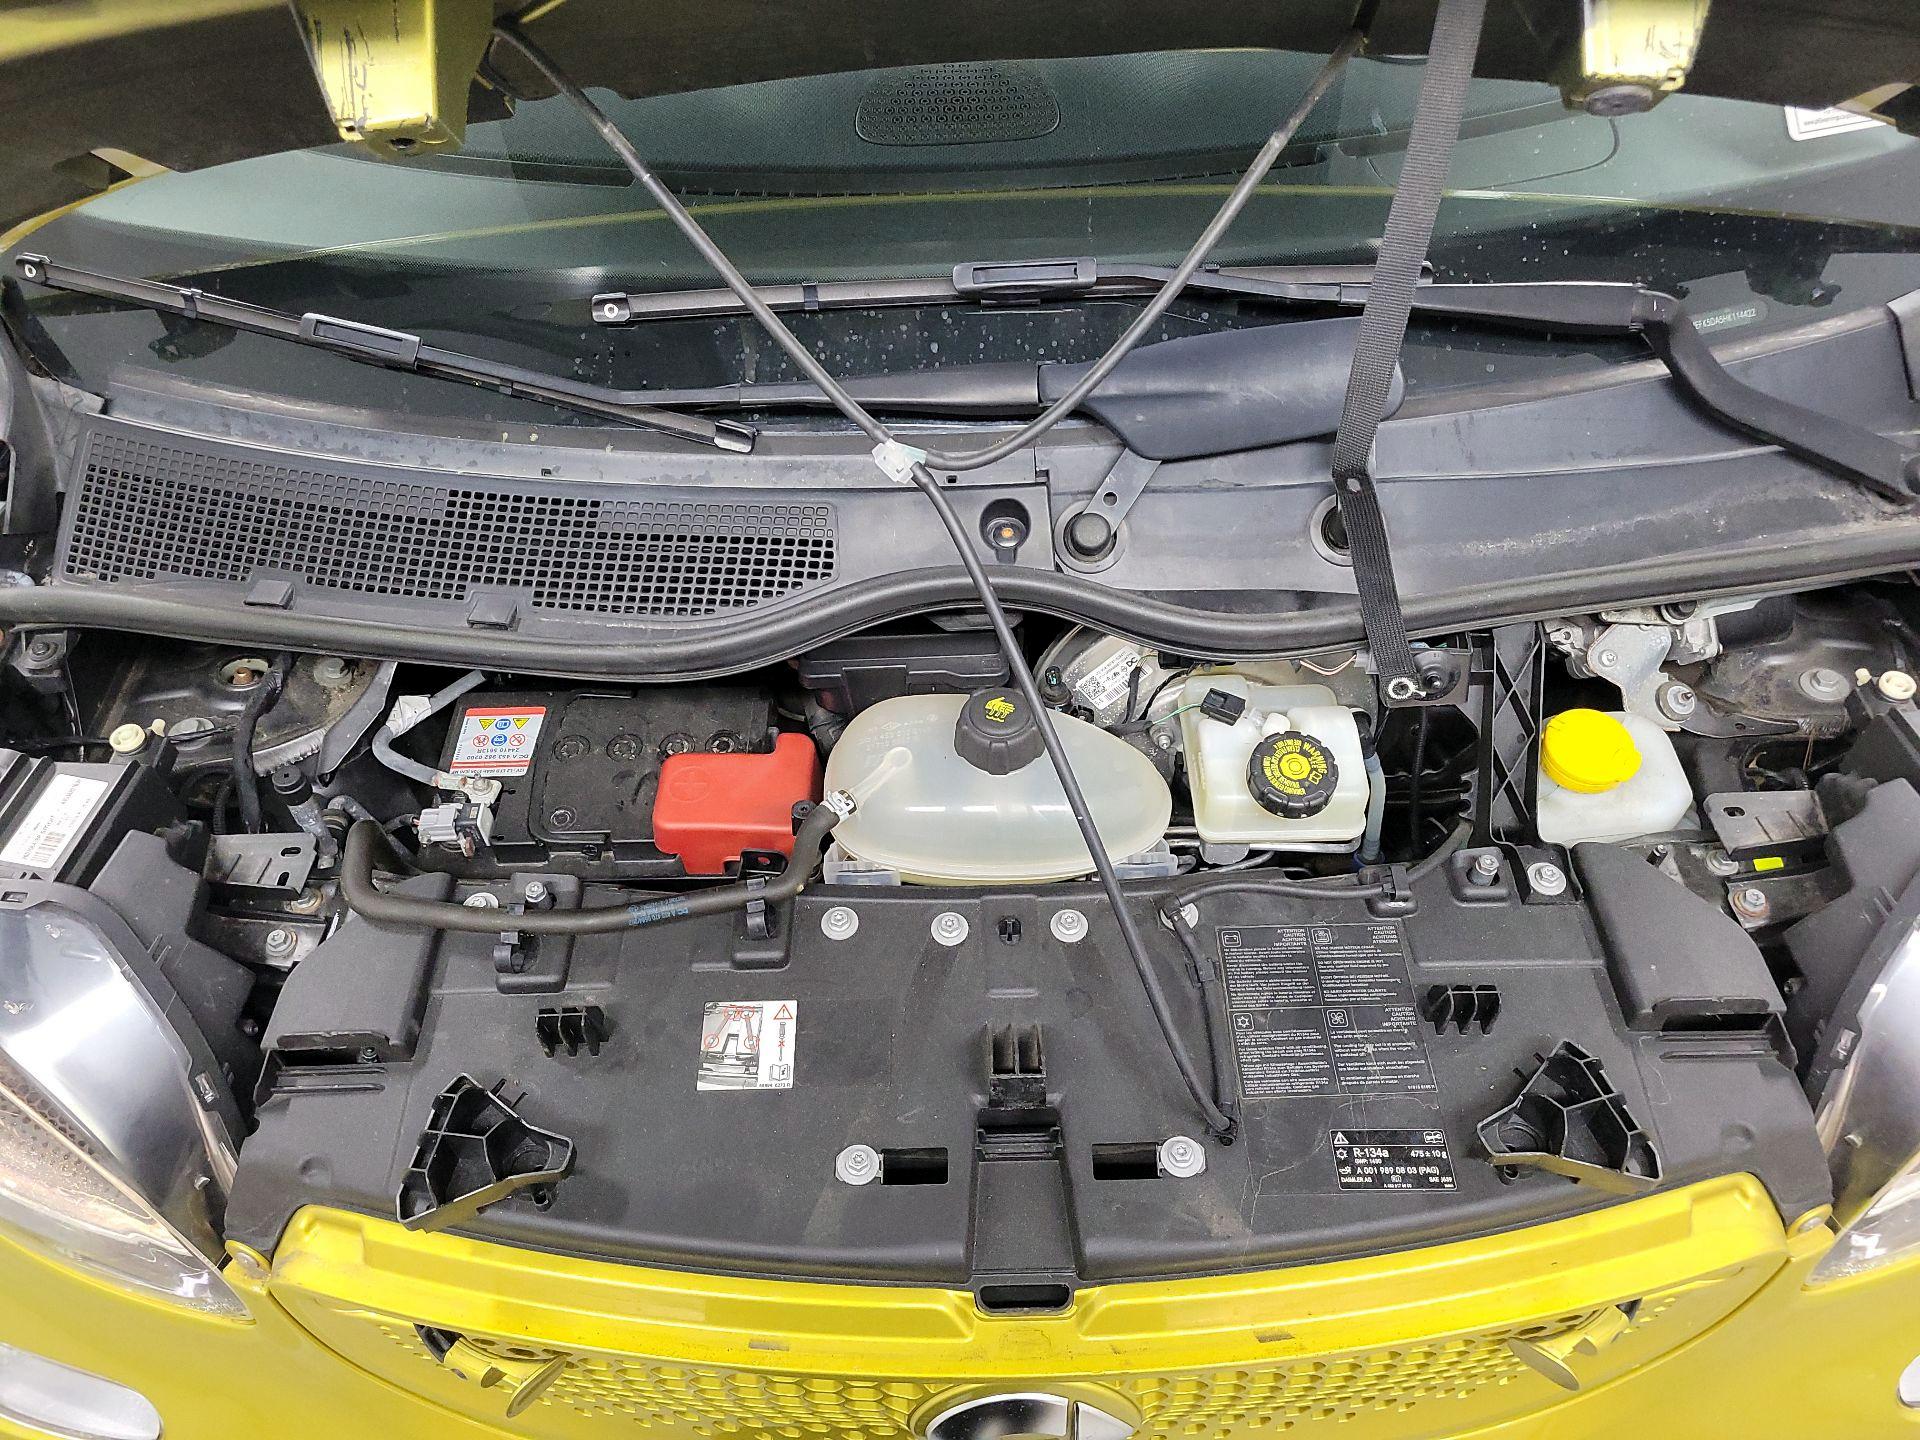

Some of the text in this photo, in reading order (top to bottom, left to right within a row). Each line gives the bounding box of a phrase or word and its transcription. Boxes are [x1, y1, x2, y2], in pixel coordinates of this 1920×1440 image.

[1303, 742, 1328, 774] WARNING
[1308, 757, 1318, 768] SEE
[1353, 1148, 1389, 1158] R-134a
[1419, 1166, 1440, 1175] (PAG)
